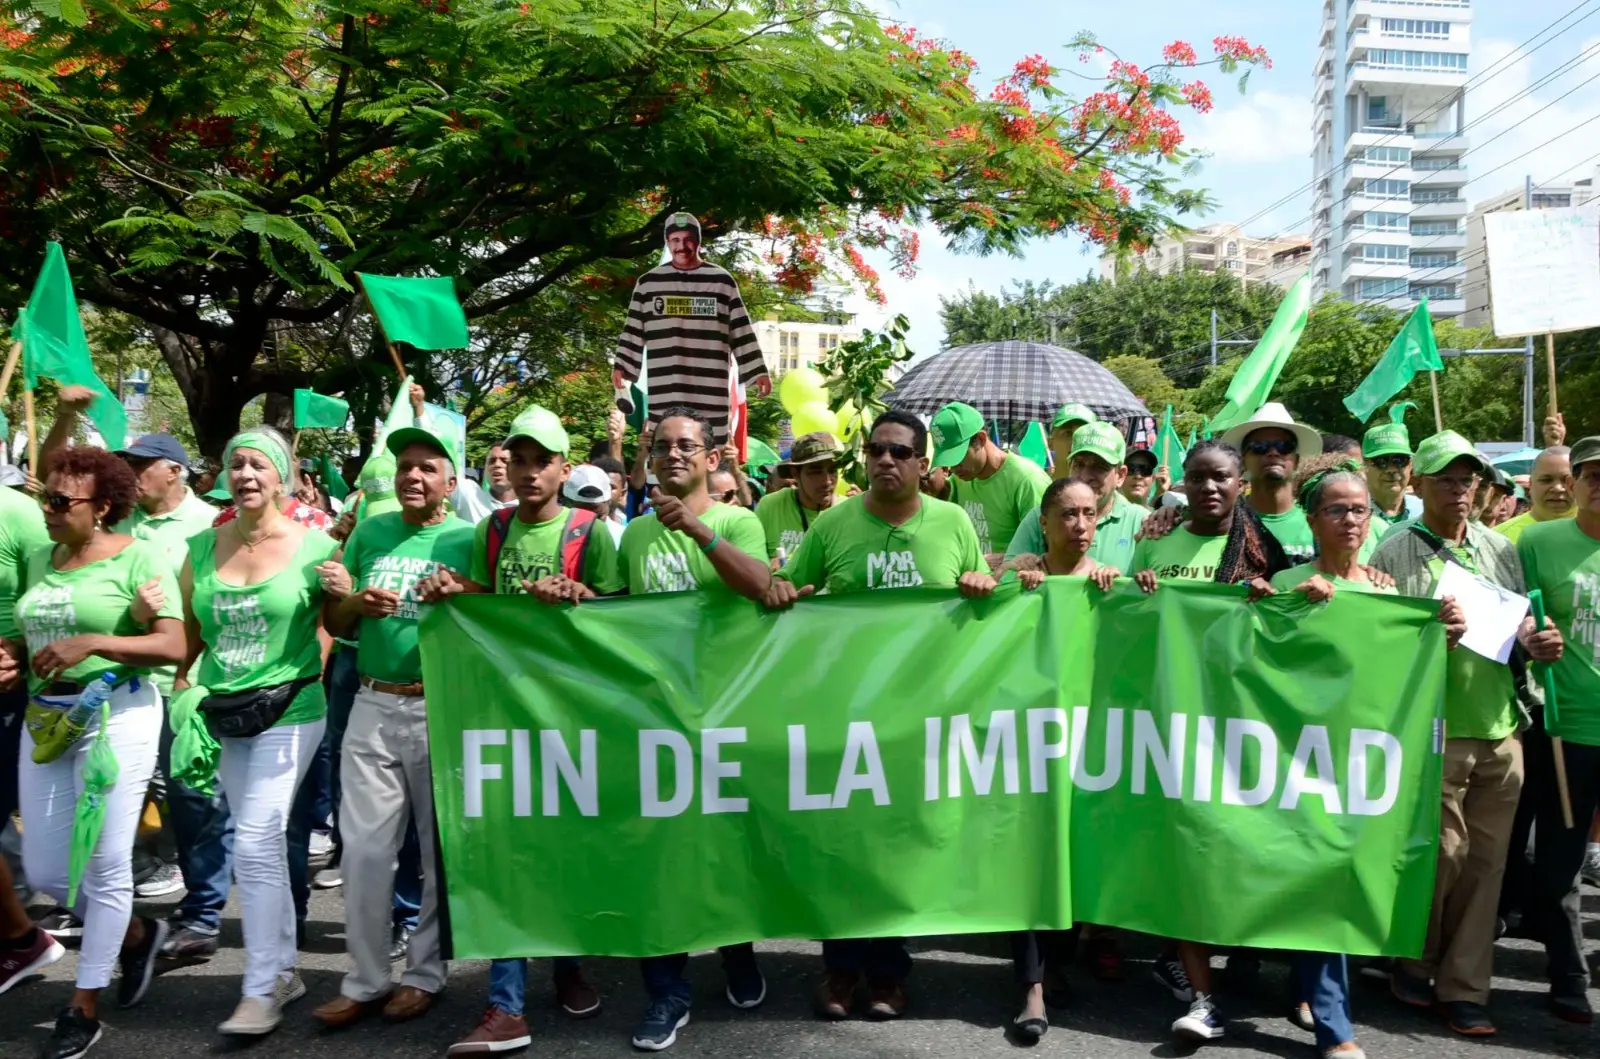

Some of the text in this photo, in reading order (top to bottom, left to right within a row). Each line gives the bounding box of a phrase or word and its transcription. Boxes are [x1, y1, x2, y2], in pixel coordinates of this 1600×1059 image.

[666, 306, 715, 315] LOS PEREGRINOS
[1160, 564, 1199, 579] #Soy
[1576, 607, 1597, 621] DEL
[462, 706, 1403, 818] FIN DE LA IMPUNIDAD
